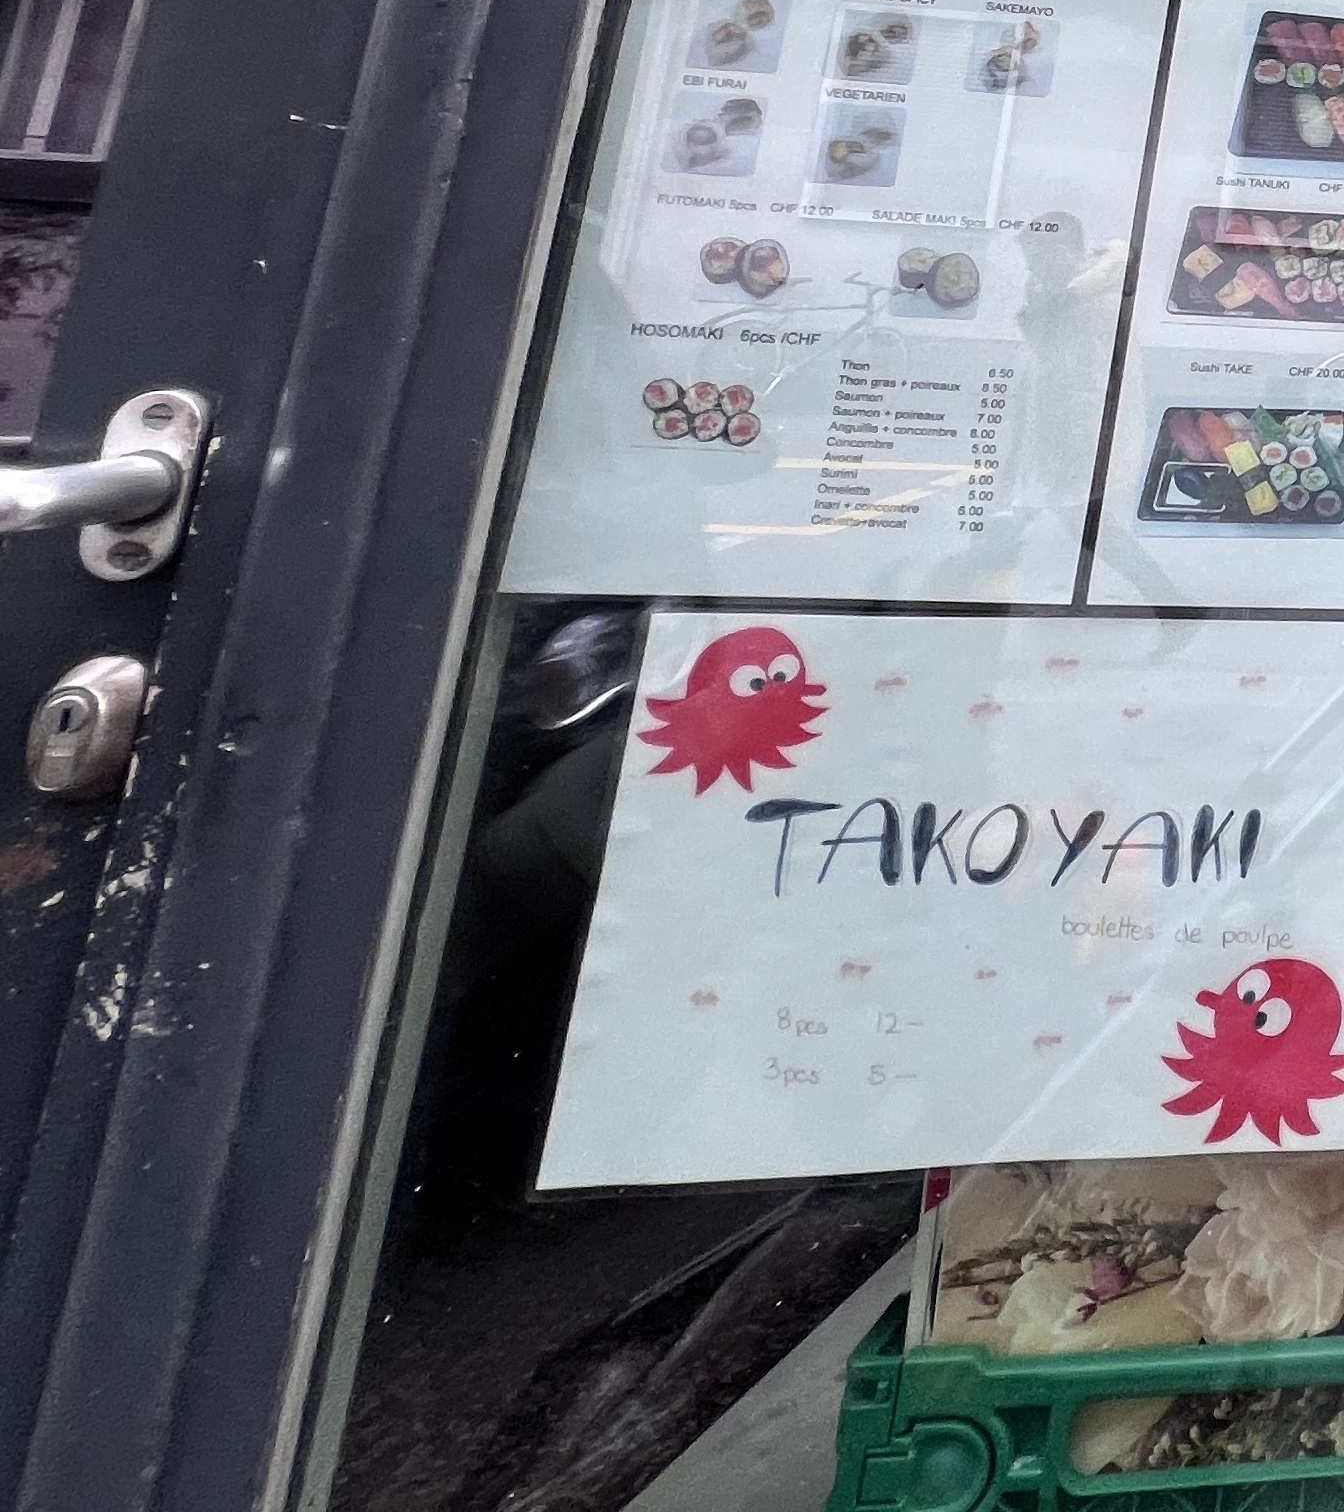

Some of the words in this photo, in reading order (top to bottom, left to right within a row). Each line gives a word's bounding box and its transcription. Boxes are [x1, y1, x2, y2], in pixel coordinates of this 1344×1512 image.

[985, 1, 1053, 17] SAKEMAYO
[825, 87, 906, 103] VEGETARIEN
[1215, 175, 1246, 188] Sushi
[1250, 178, 1290, 190] TANUKI
[1318, 182, 1344, 194] CHF
[657, 194, 725, 210] FUTOMAKI
[770, 203, 797, 214] CHF
[872, 209, 922, 223] SALADE
[925, 213, 956, 226] MAKI
[999, 218, 1023, 230] CHF
[631, 323, 724, 340] HOSOMAKI
[740, 329, 776, 345] 6pcs
[1190, 361, 1220, 374] Sushi
[1223, 363, 1254, 375] TAKE
[1289, 366, 1313, 378] CHF
[745, 797, 1263, 898] TAKOYAKI
[1062, 915, 1155, 942] boulettes
[1175, 922, 1201, 944] de
[1222, 924, 1293, 952] poulpe
